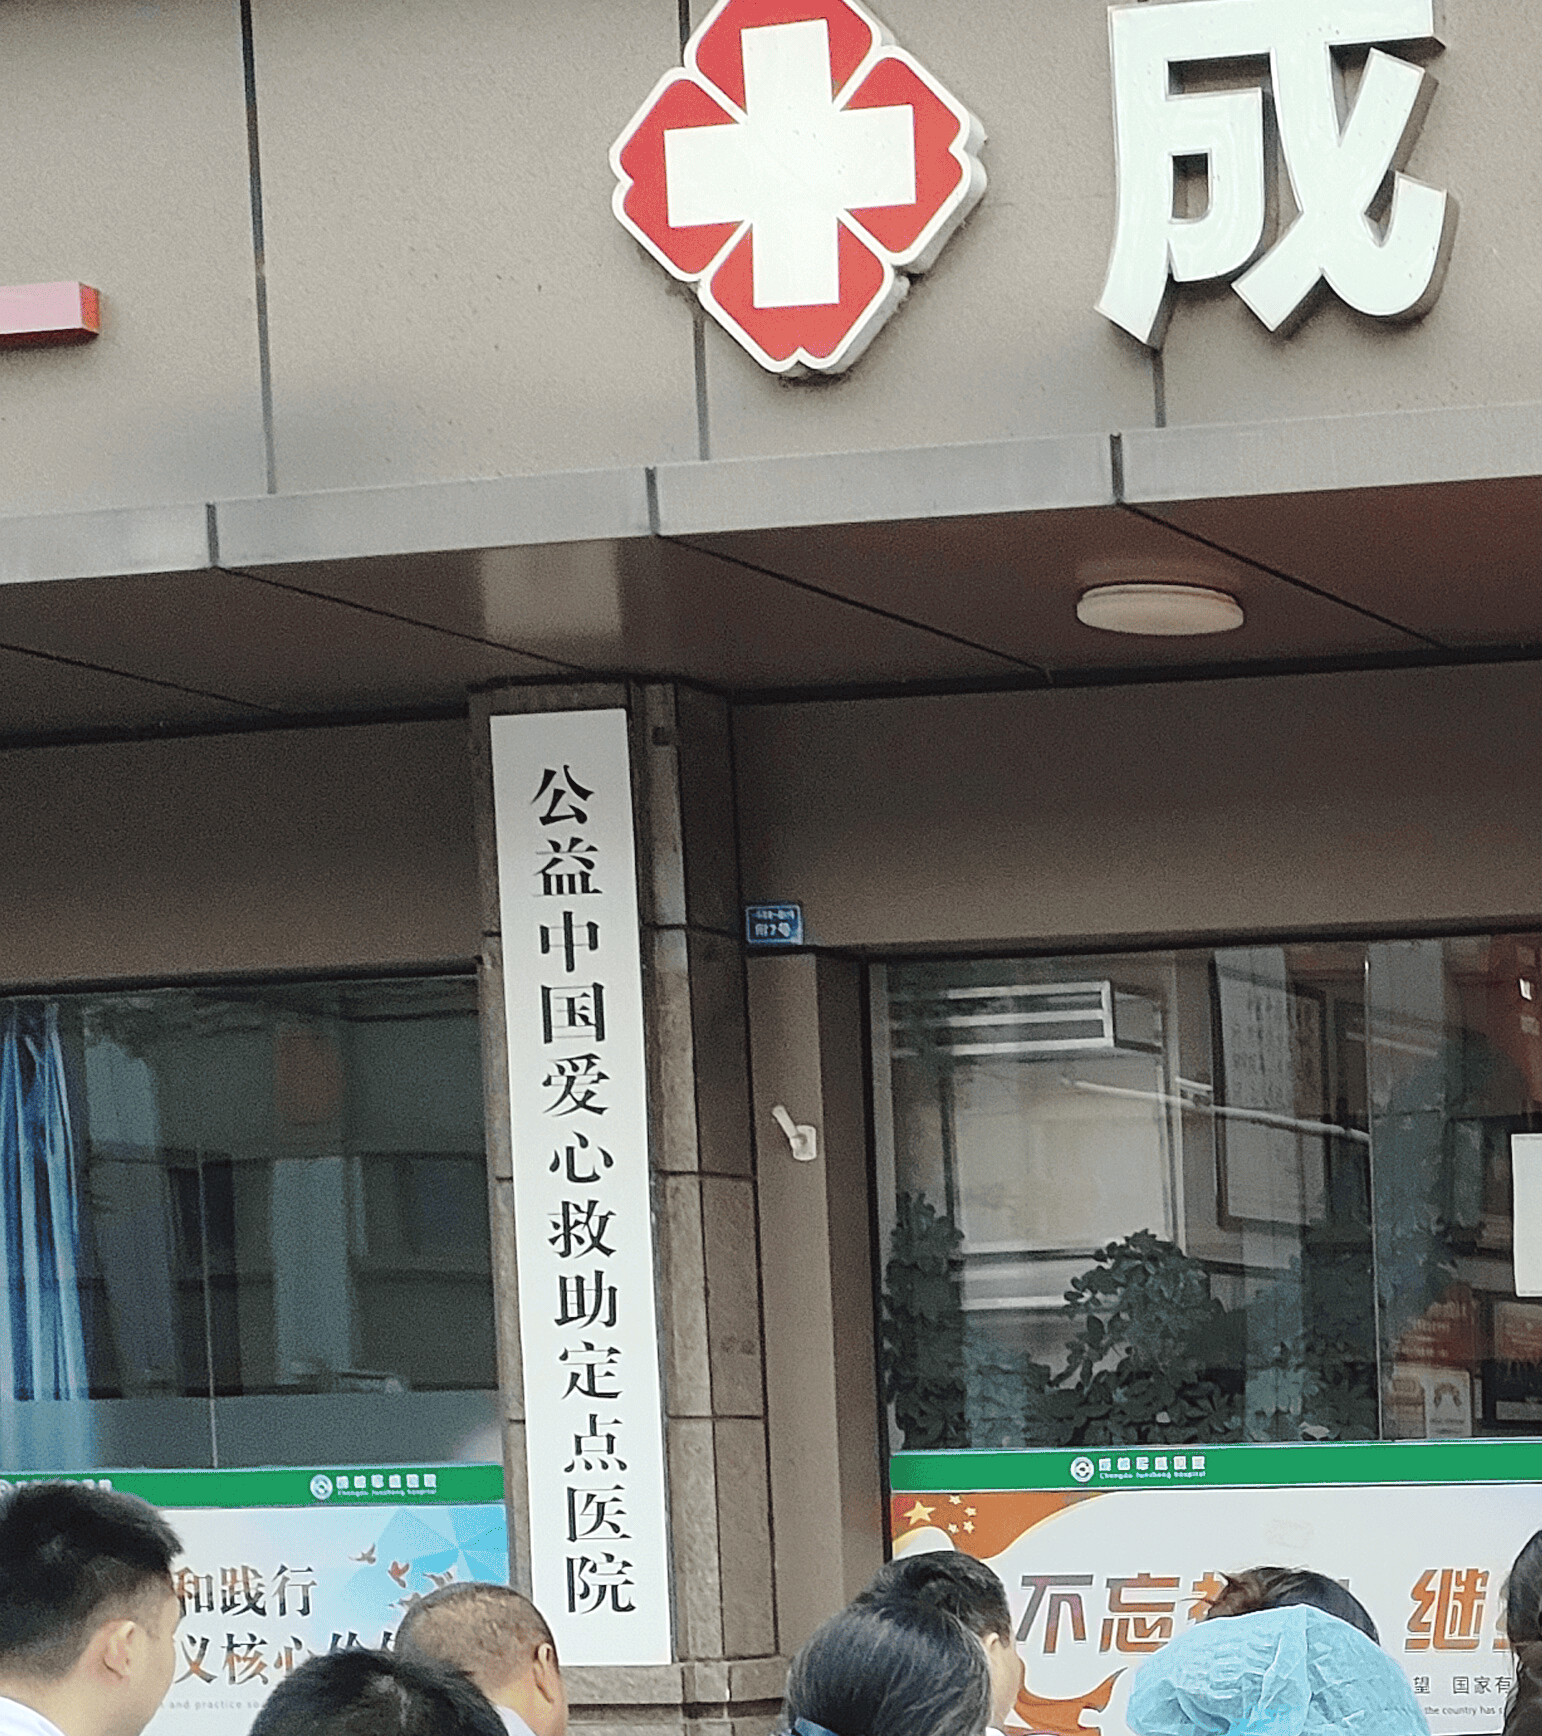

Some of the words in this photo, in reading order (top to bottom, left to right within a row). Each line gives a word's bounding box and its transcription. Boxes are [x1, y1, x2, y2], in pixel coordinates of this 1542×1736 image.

[530, 763, 637, 1617] 公益中国爱心救助定点医院
[174, 1564, 318, 1618] 和践行
[1404, 1568, 1510, 1654] 继
[1412, 1675, 1431, 1695] 望
[1452, 1675, 1512, 1695] 国家有
[194, 1700, 243, 1711] practice
[1424, 1706, 1440, 1715] the
[1442, 1705, 1477, 1717] country
[1480, 1705, 1496, 1715] has
